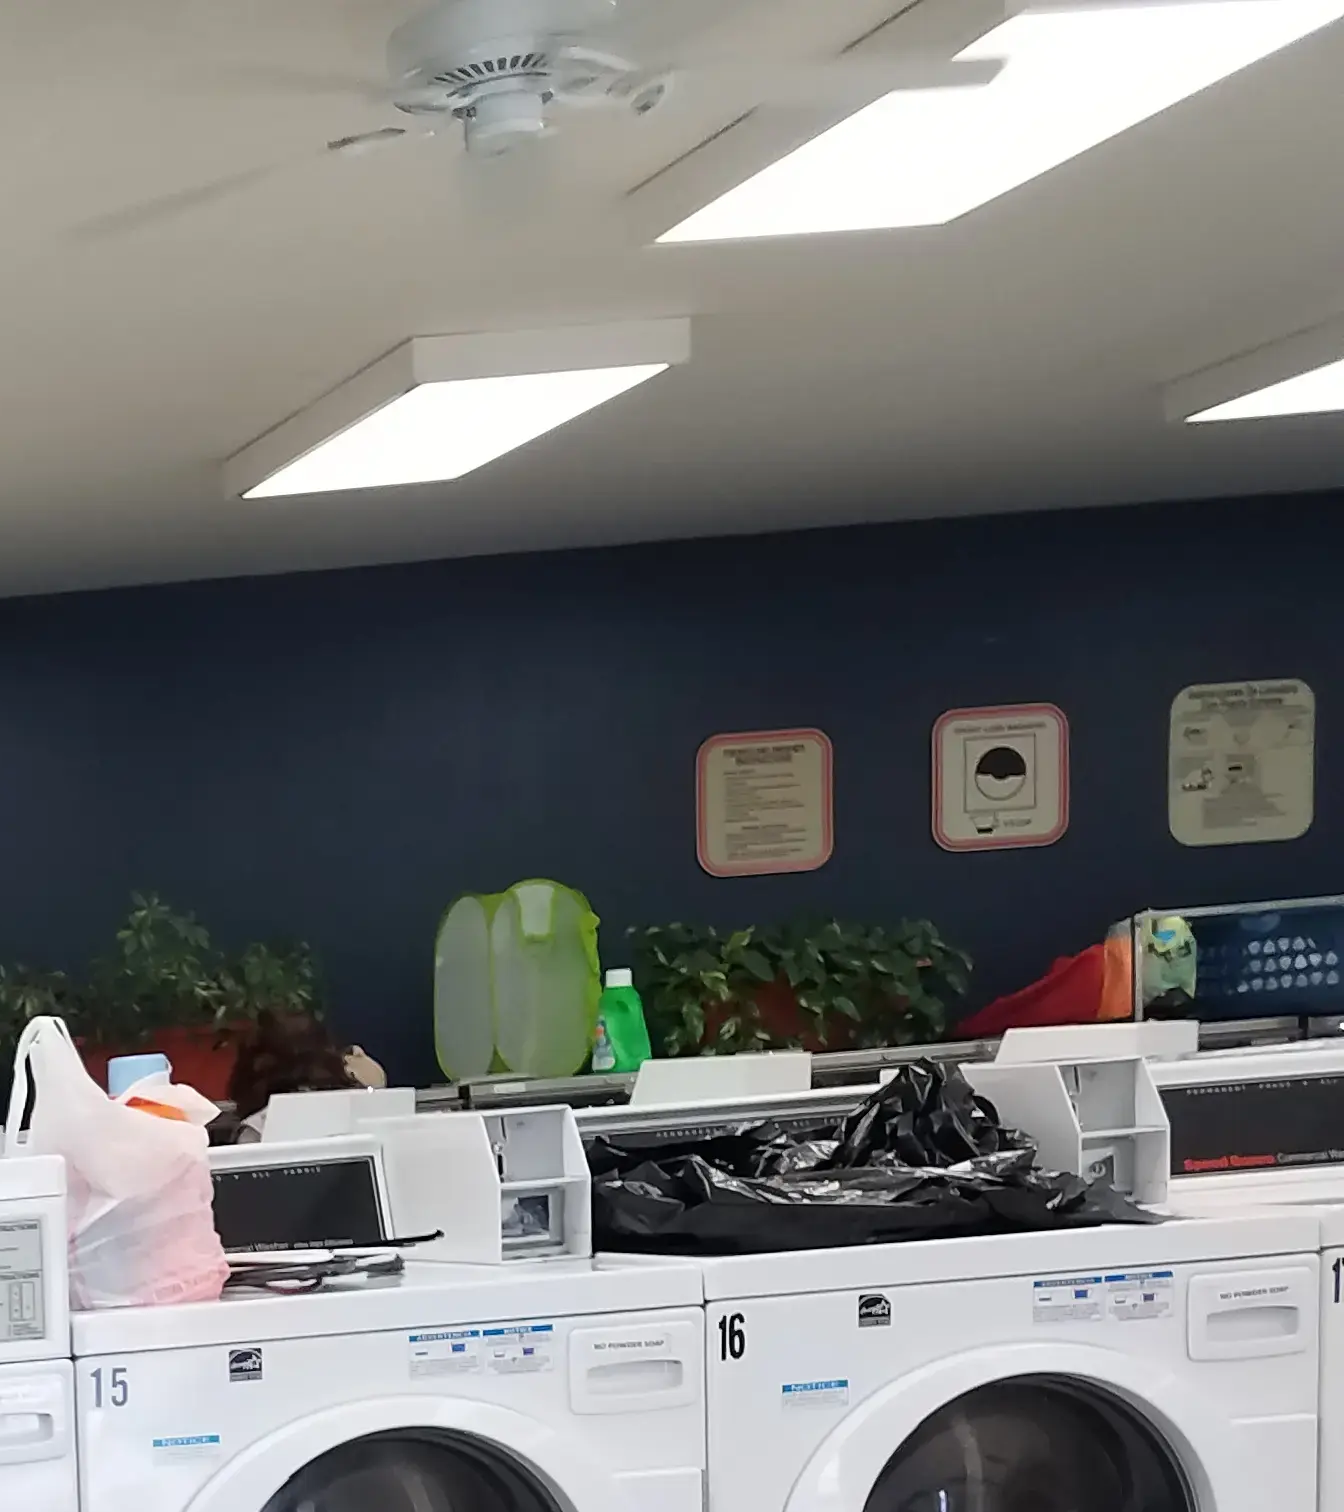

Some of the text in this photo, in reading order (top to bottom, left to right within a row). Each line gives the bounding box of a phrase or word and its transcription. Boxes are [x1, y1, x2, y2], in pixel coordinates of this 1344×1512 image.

[1332, 1257, 1344, 1304] 1
[718, 1312, 747, 1361] 16
[90, 1367, 128, 1408] 15
